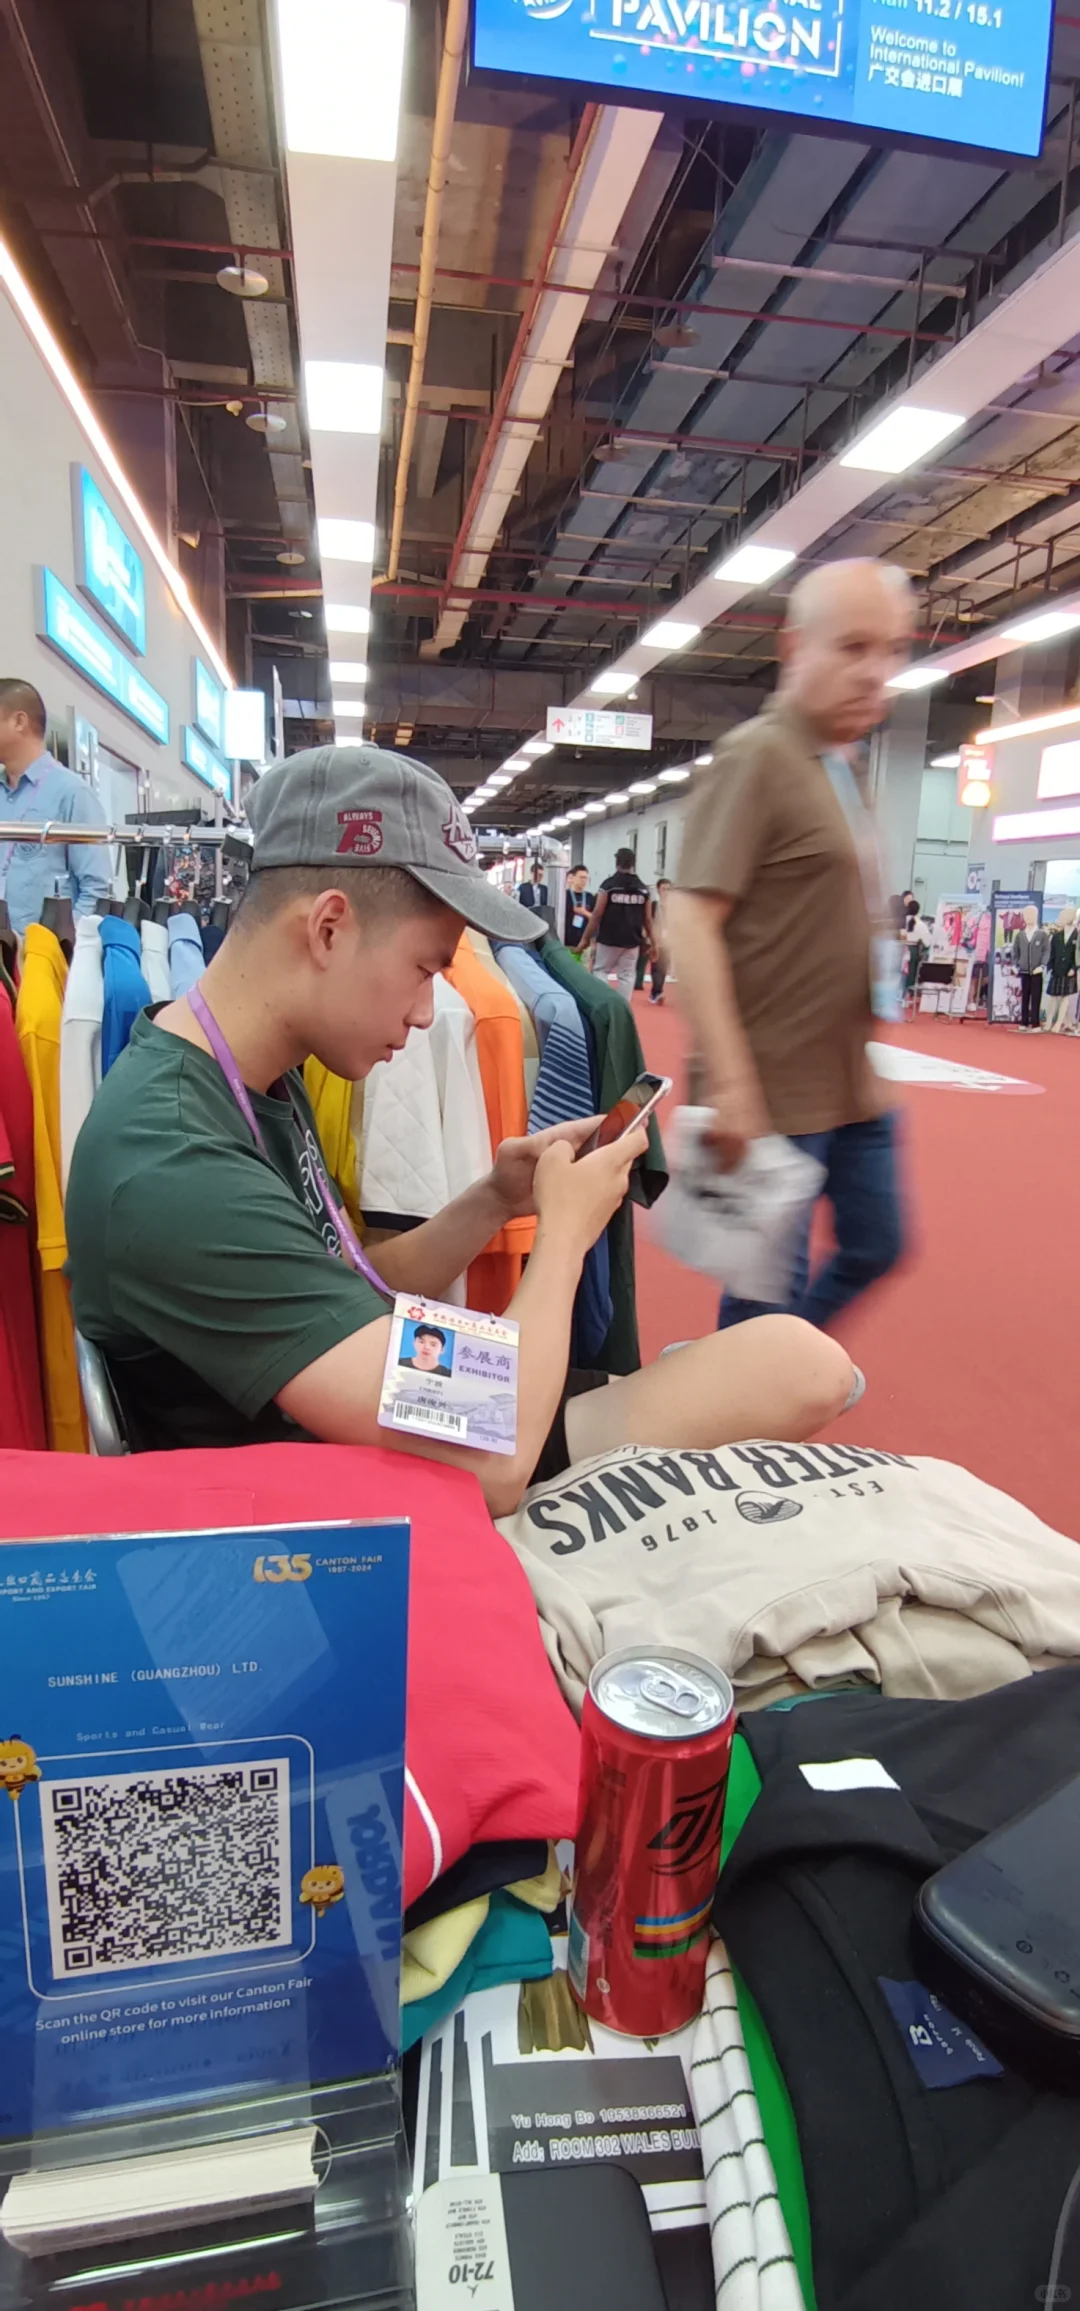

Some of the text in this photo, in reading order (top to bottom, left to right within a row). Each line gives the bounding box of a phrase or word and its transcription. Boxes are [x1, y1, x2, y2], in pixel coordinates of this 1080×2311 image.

[611, 0, 822, 59] PAVILION
[966, 4, 1002, 29] 15.1
[870, 25, 956, 57] Welcome to
[867, 63, 964, 98] 广交会进口展
[870, 43, 1025, 89] International Pavilion!
[343, 812, 374, 822] ALWAYS
[457, 1345, 513, 1371] 参展商
[458, 1364, 511, 1384] EXHIBITOR
[527, 1452, 740, 1556] BANKS
[641, 1509, 718, 1552] 1876
[253, 1553, 313, 1583] 135
[316, 1554, 383, 1567] CANTON FAIR
[48, 1661, 263, 1688] SUNSHINE (GUANGZHOU) LTD.
[76, 1731, 118, 1742] Sports
[125, 1727, 146, 1738] and
[152, 1724, 191, 1735] Casual
[35, 1977, 314, 2032] Scan the QR code to visit our Canton Fair
[61, 1998, 291, 2044] online store for more information
[511, 2113, 532, 2129] Yu
[574, 2110, 595, 2125] Bo
[599, 2103, 687, 2124] 19538366521
[549, 2136, 595, 2162] ROOM
[595, 2134, 621, 2158] 302
[620, 2130, 672, 2155] WALES
[448, 2260, 495, 2284] 72-10
